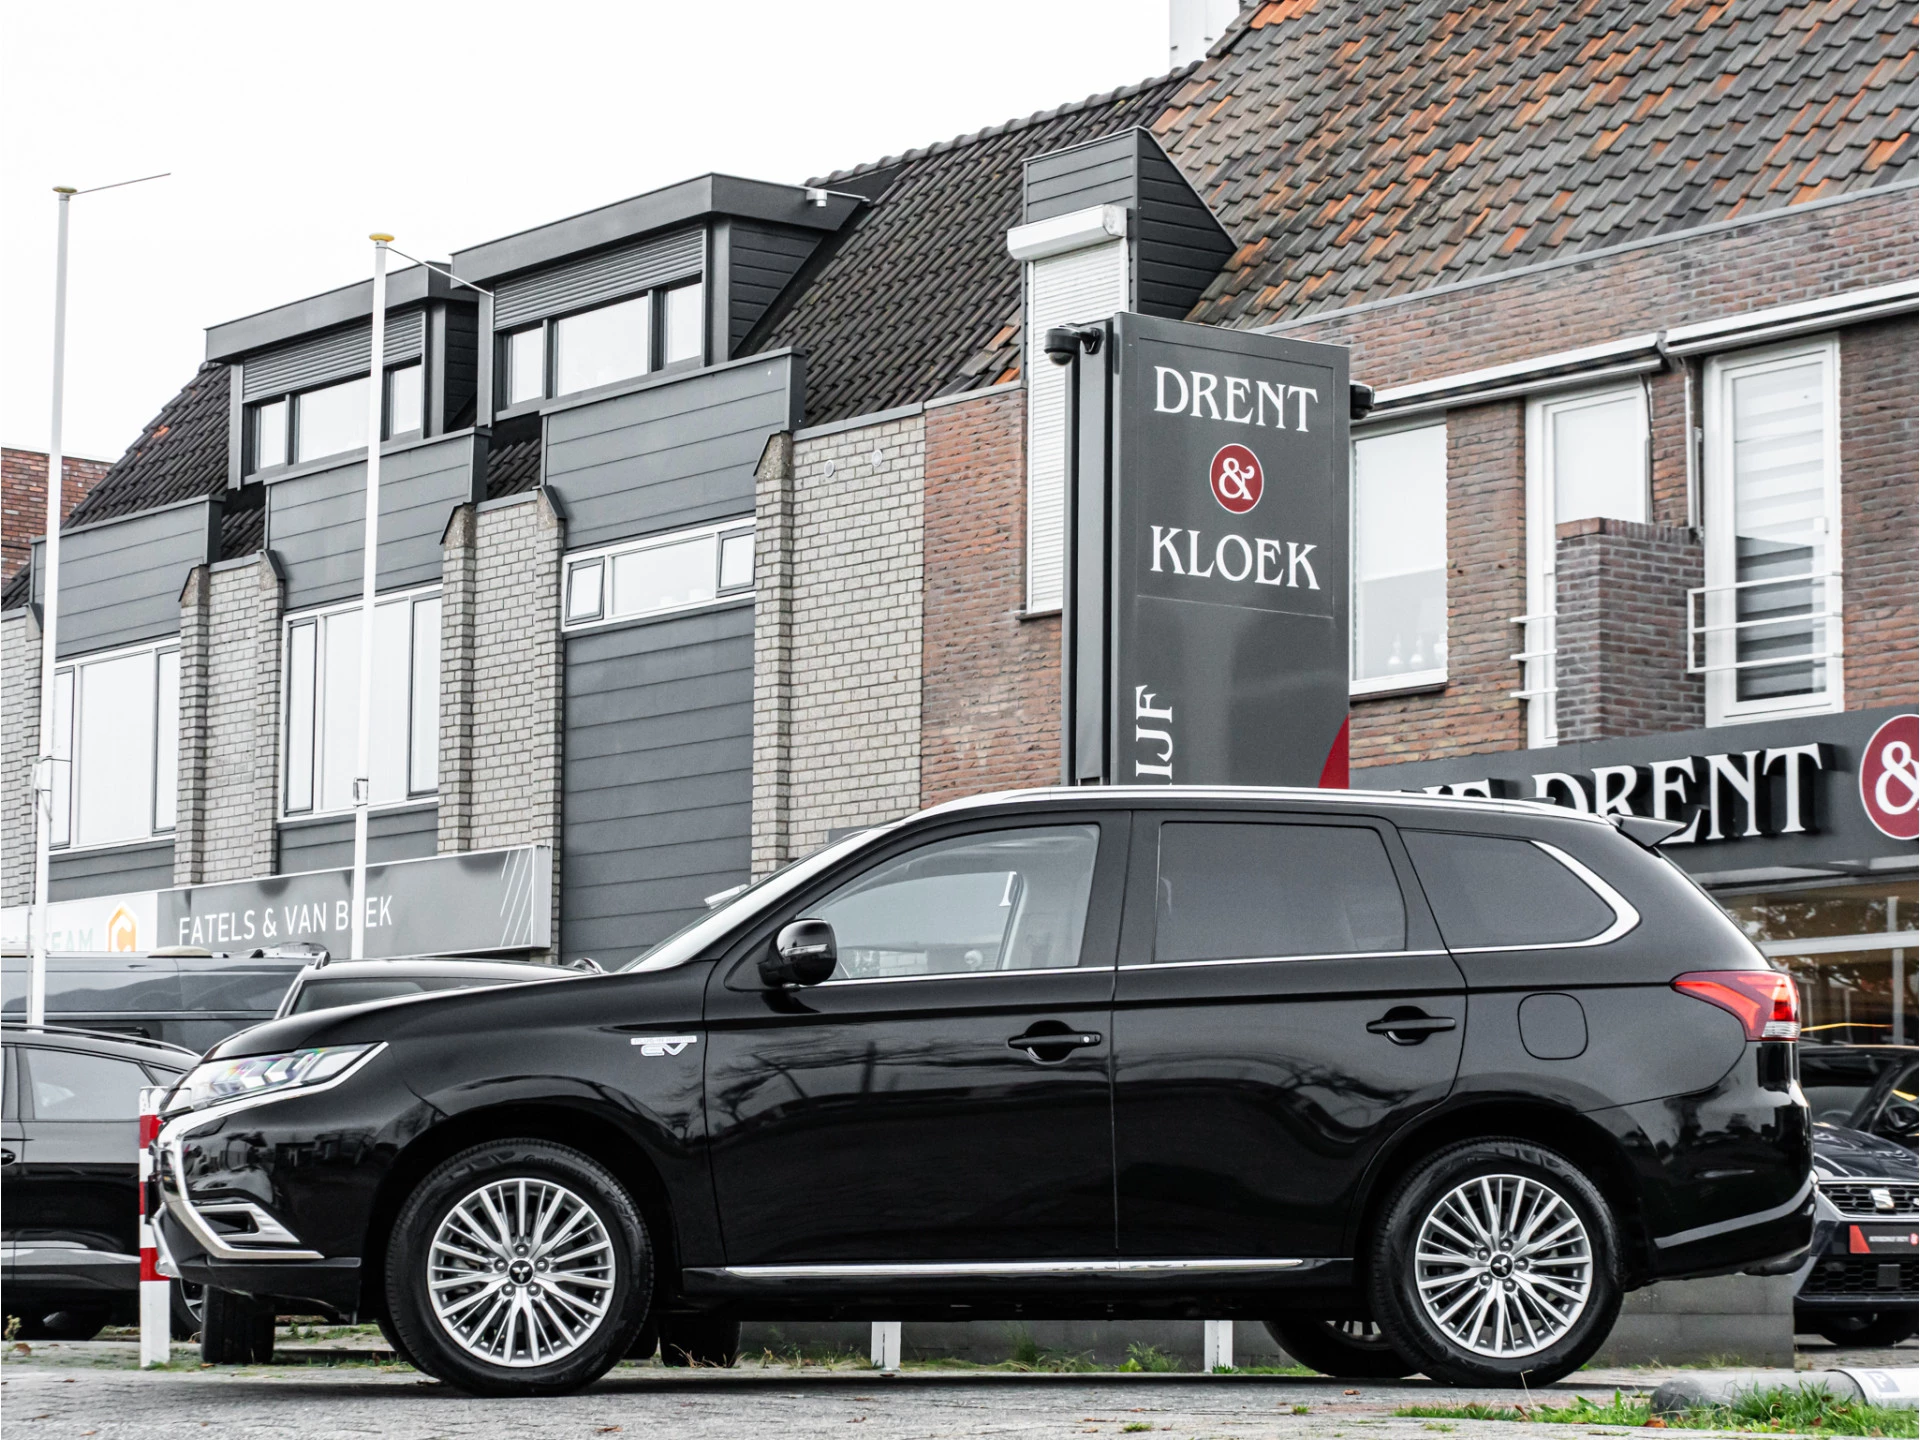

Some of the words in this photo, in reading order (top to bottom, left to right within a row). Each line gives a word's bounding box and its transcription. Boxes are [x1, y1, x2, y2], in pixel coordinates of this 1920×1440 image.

[1153, 365, 1319, 433] DRENT
[1218, 457, 1255, 501] &
[1150, 525, 1321, 591] KLOEK
[1135, 684, 1174, 786] IJF
[1531, 743, 1822, 844] DRENT
[179, 909, 256, 947] FATELS
[262, 907, 278, 939] &
[284, 901, 327, 936] VAN
[335, 894, 393, 931] BEK
